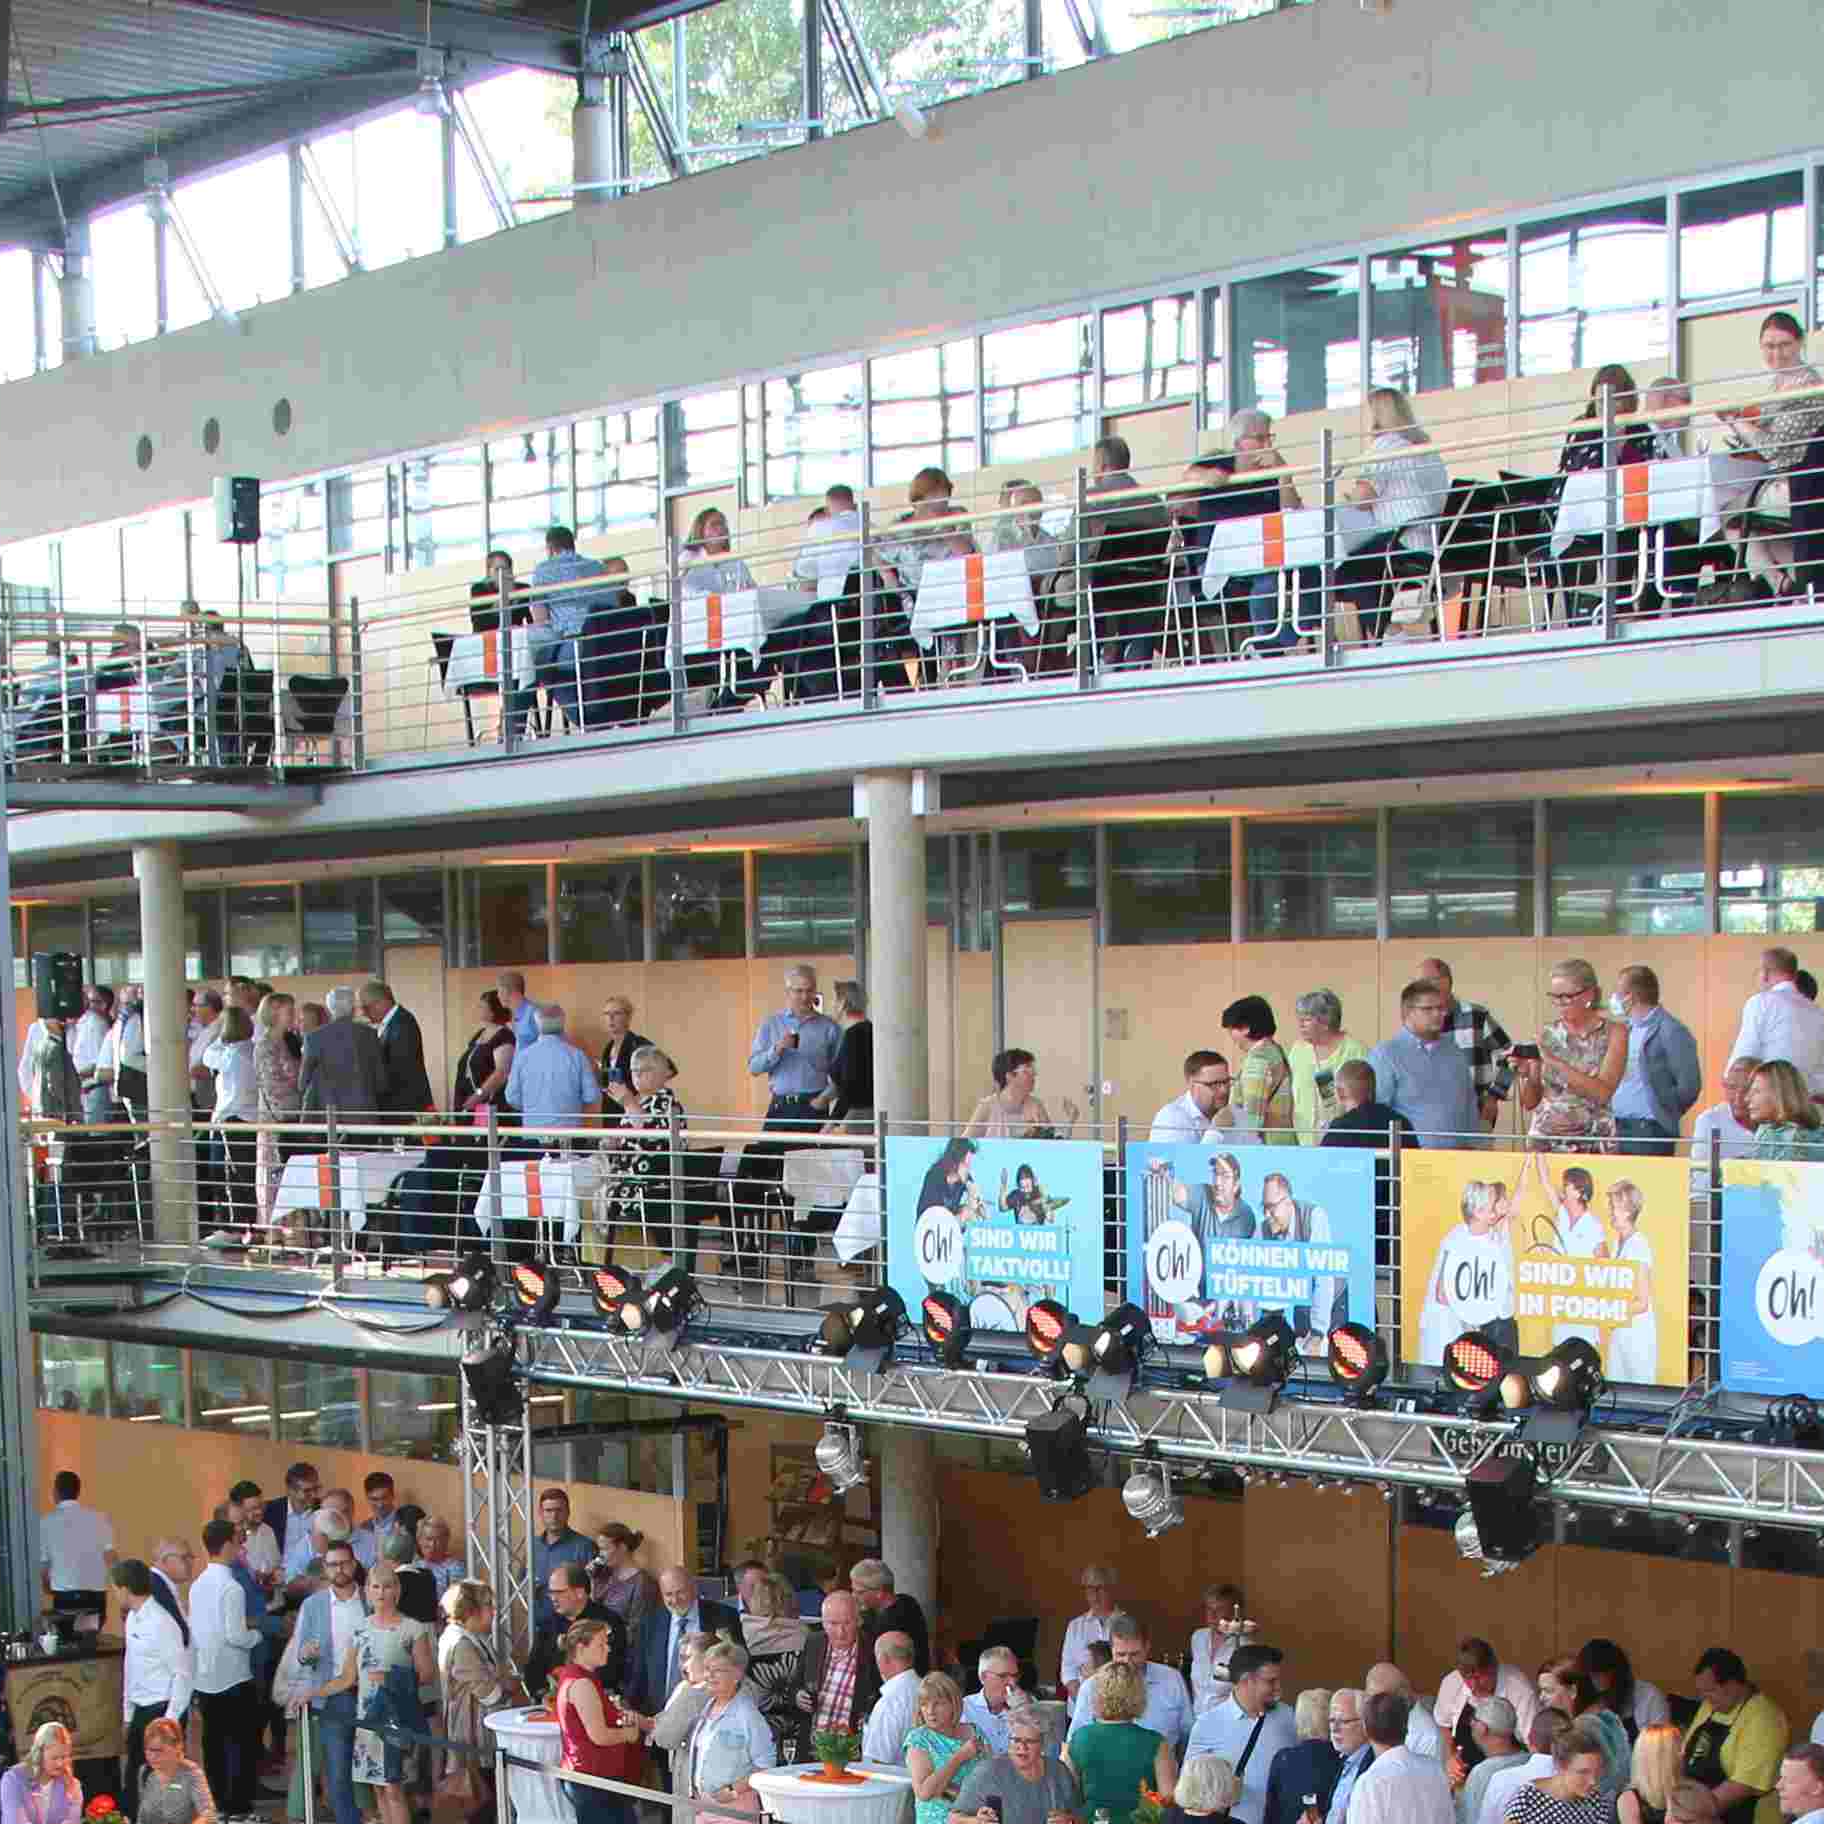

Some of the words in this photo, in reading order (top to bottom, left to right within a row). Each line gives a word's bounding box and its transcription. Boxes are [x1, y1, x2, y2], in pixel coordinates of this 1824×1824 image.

[922, 1223, 953, 1263] Oh!
[971, 1228, 1014, 1249] SIND
[1019, 1231, 1057, 1252] WIR
[1210, 1238, 1299, 1269] KÖNNEN
[1304, 1248, 1349, 1272] WIR
[971, 1256, 1071, 1279] TAKTVOLL!
[1156, 1239, 1191, 1281] Oh!
[1520, 1262, 1576, 1286] SIND
[1584, 1265, 1633, 1288] WIR
[1211, 1270, 1309, 1298] TÜFTELN!
[1455, 1256, 1496, 1301] Oh!
[1519, 1293, 1545, 1315] IN
[1551, 1296, 1628, 1320] FORM!
[1768, 1270, 1817, 1320] Oh!
